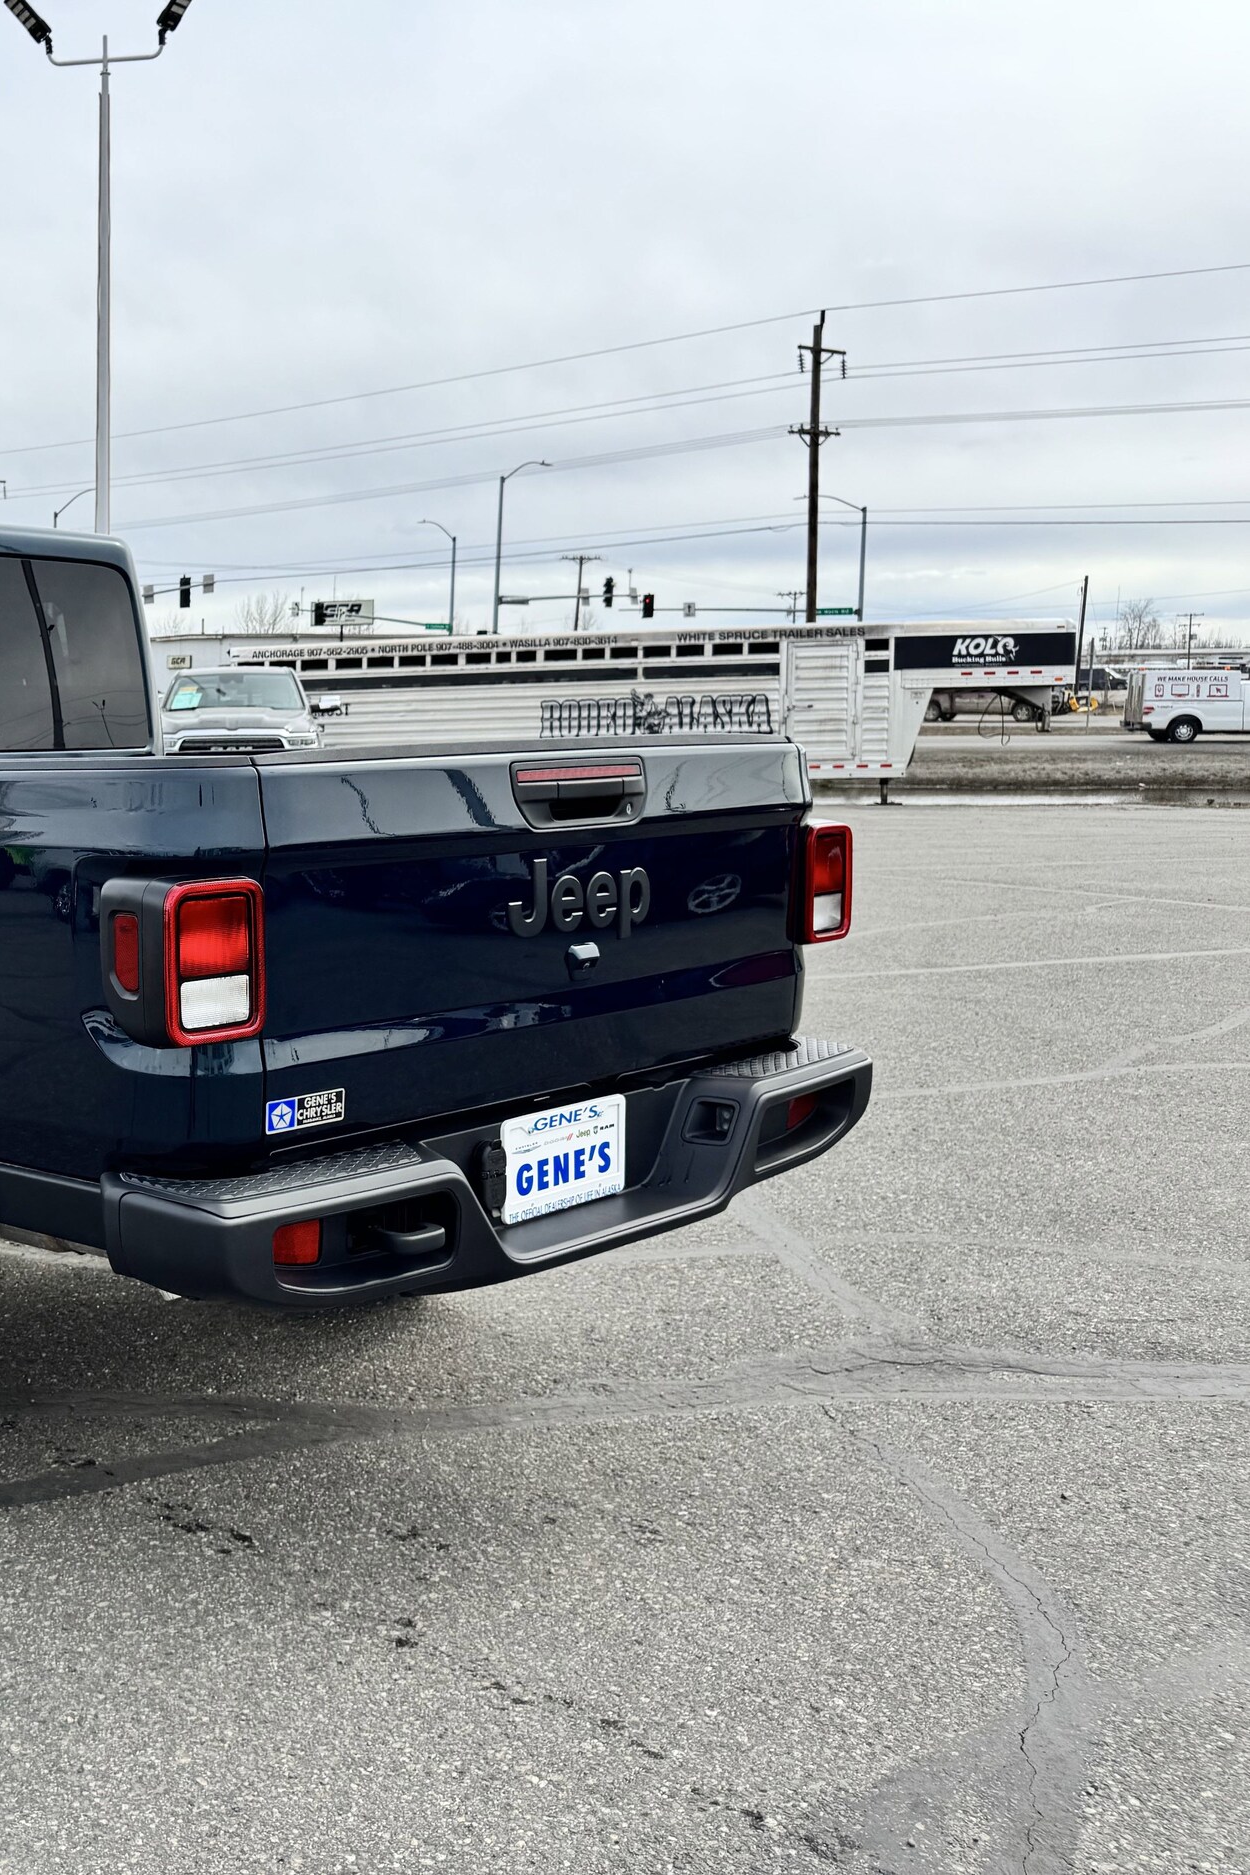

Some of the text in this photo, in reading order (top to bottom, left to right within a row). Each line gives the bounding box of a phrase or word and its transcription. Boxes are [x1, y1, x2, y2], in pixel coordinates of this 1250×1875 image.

[677, 627, 866, 643] WHITE SPRUCE TRAILER SALES
[252, 648, 305, 659] ANCHORAGE
[378, 644, 409, 654] NORTH
[410, 643, 434, 653] POLE
[509, 638, 550, 649] WASILLA
[539, 693, 773, 739] RODEO ALASKA
[508, 858, 651, 940] Jeep
[297, 1102, 342, 1120] CHRYSLER
[304, 1092, 337, 1108] GENE'S
[533, 1105, 598, 1131] GENE'S
[576, 1128, 591, 1138] Jeep
[599, 1123, 615, 1131] RAM
[516, 1141, 611, 1196] GENE'S
[509, 1213, 519, 1223] THE
[575, 1195, 583, 1204] OF
